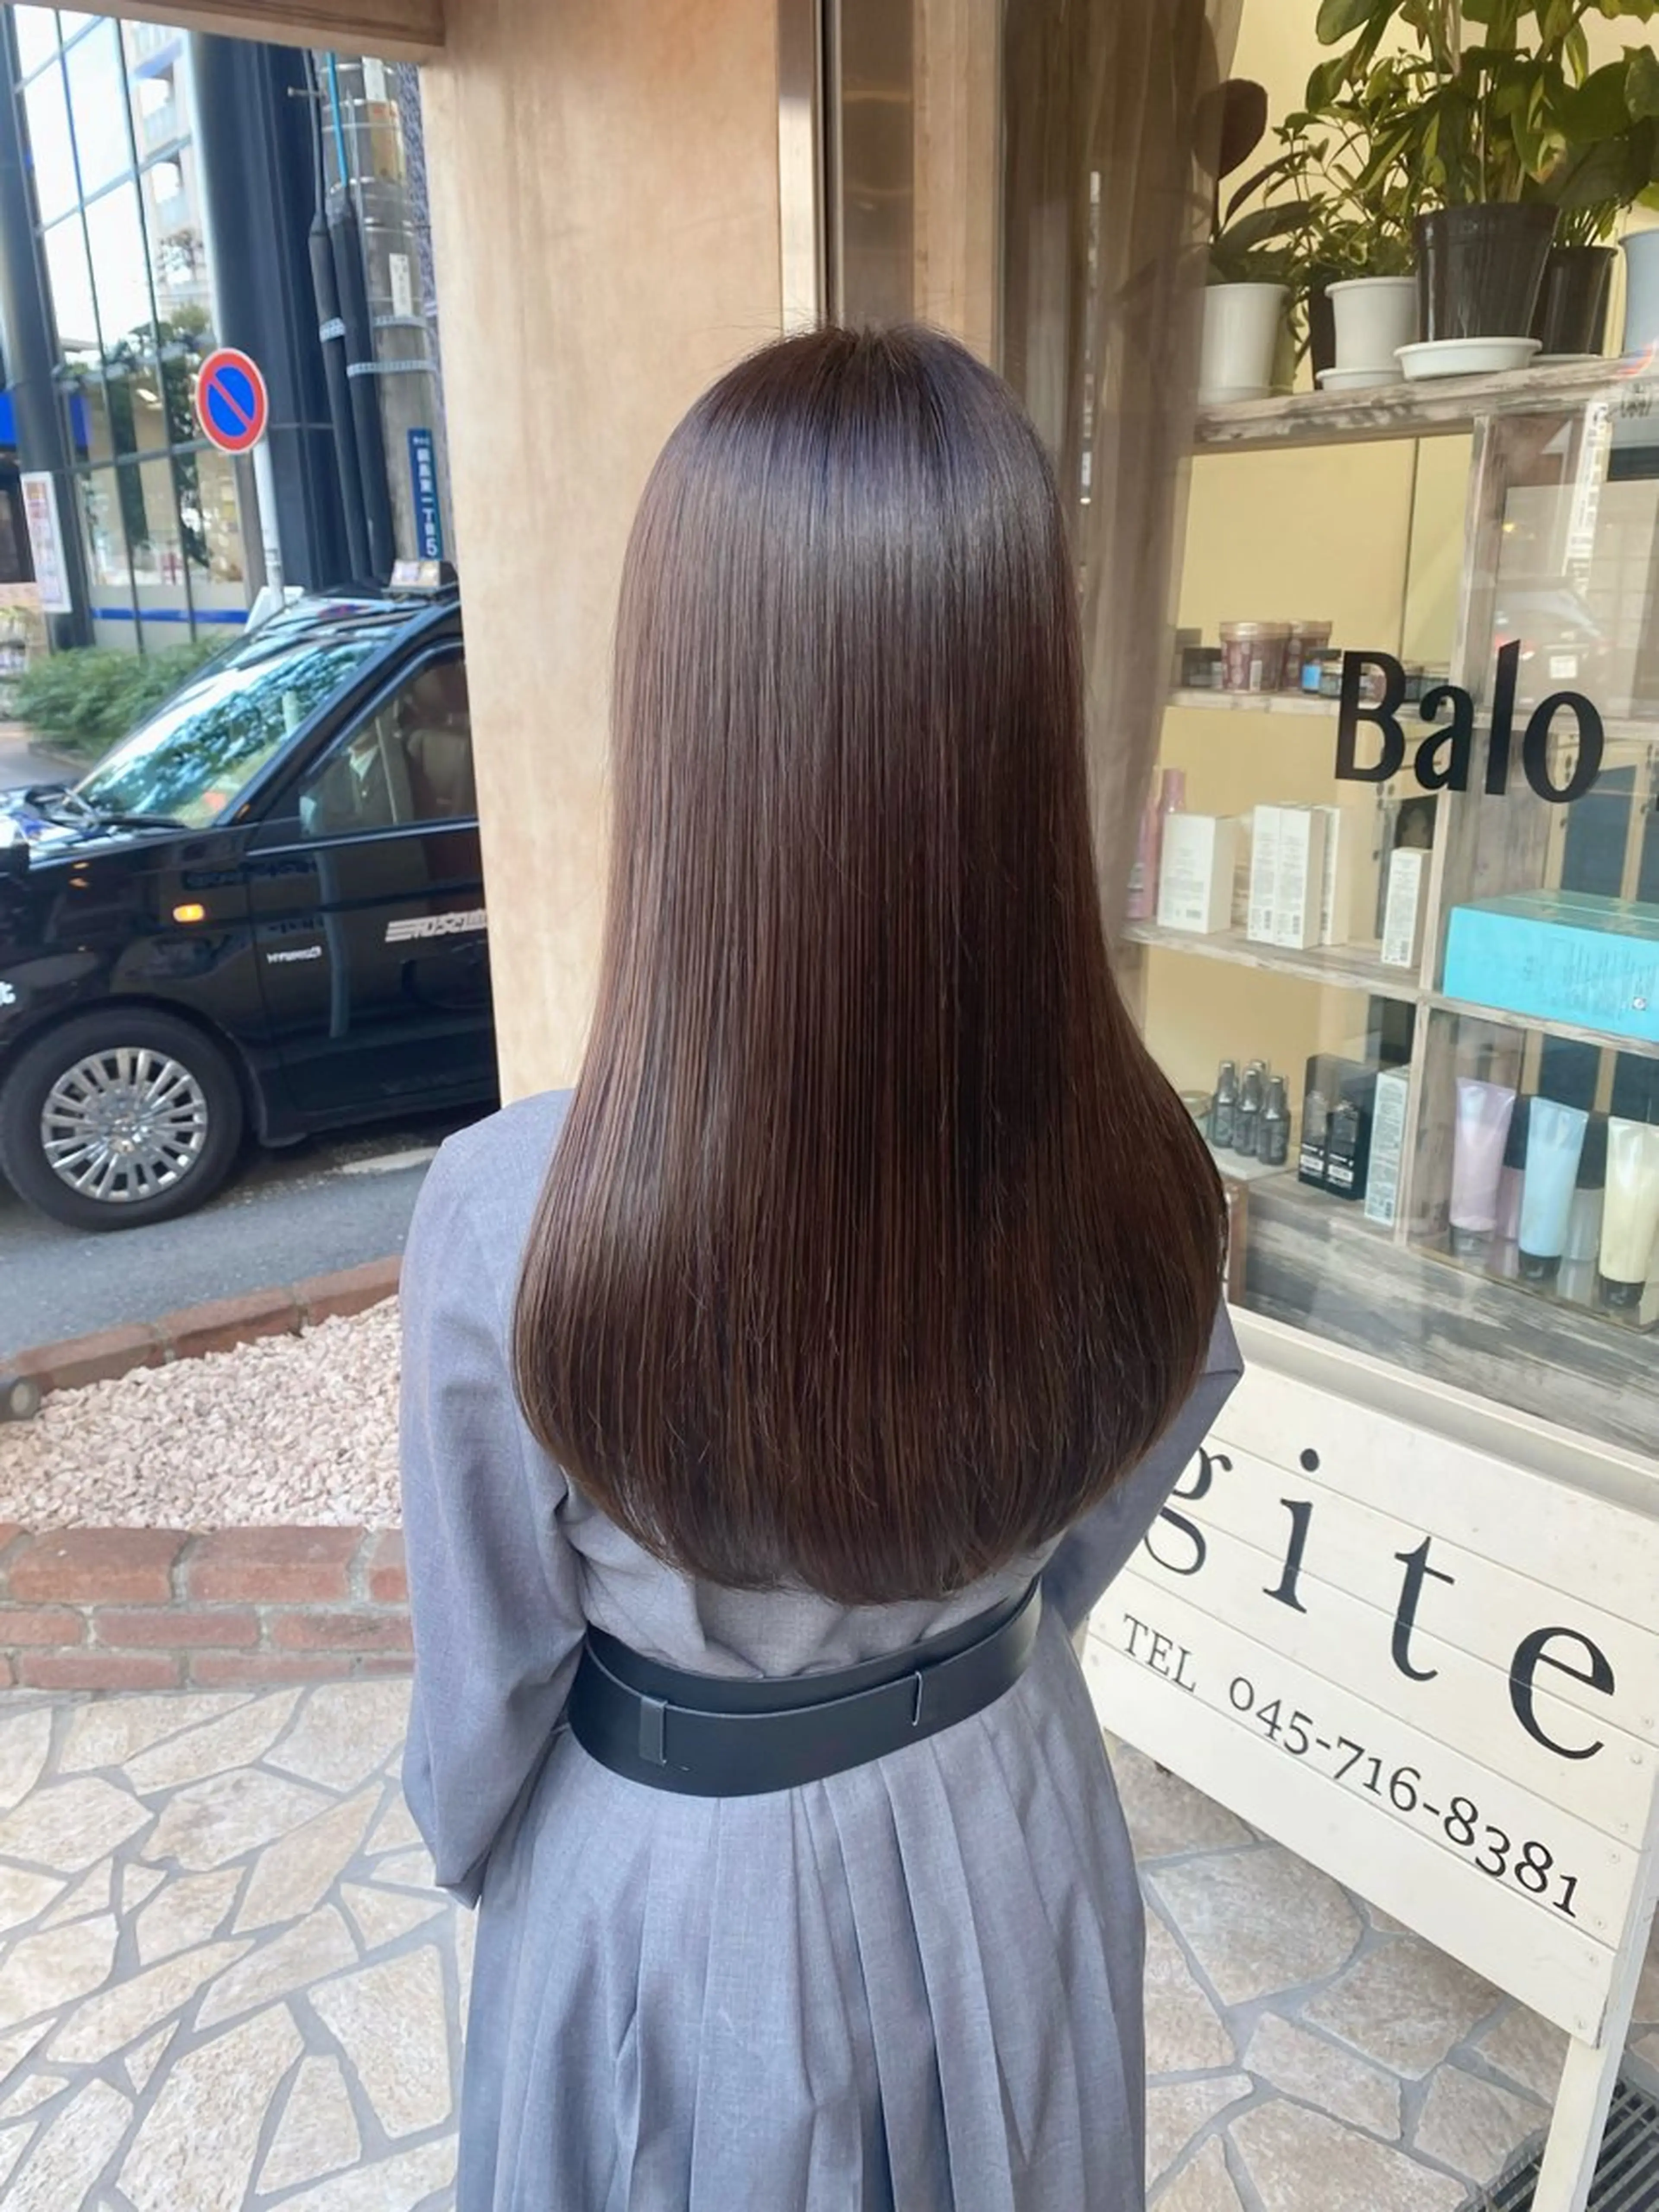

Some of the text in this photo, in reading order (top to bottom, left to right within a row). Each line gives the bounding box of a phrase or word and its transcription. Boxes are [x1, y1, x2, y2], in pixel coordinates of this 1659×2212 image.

[1335, 639, 1605, 803] Balo
[1142, 1446, 1616, 1761] gite
[1123, 1614, 1580, 1918] TEL 045-716-8381
